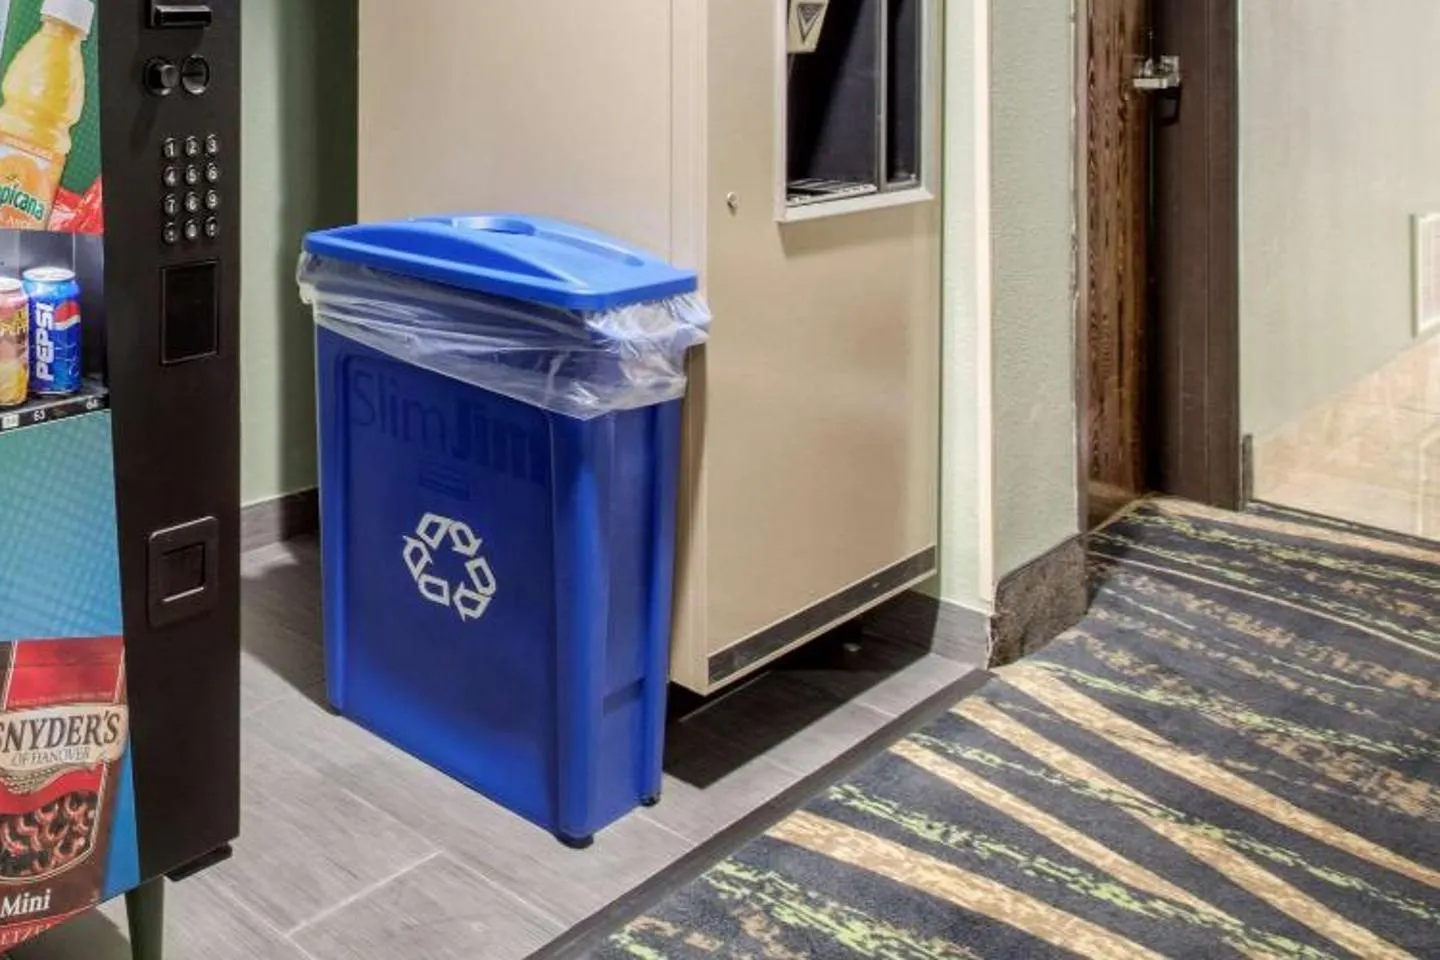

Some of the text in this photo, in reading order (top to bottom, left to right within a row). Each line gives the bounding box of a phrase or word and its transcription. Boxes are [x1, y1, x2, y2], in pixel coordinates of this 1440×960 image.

[12, 746, 91, 767] OF HANOVER
[0, 888, 51, 918] Mini
